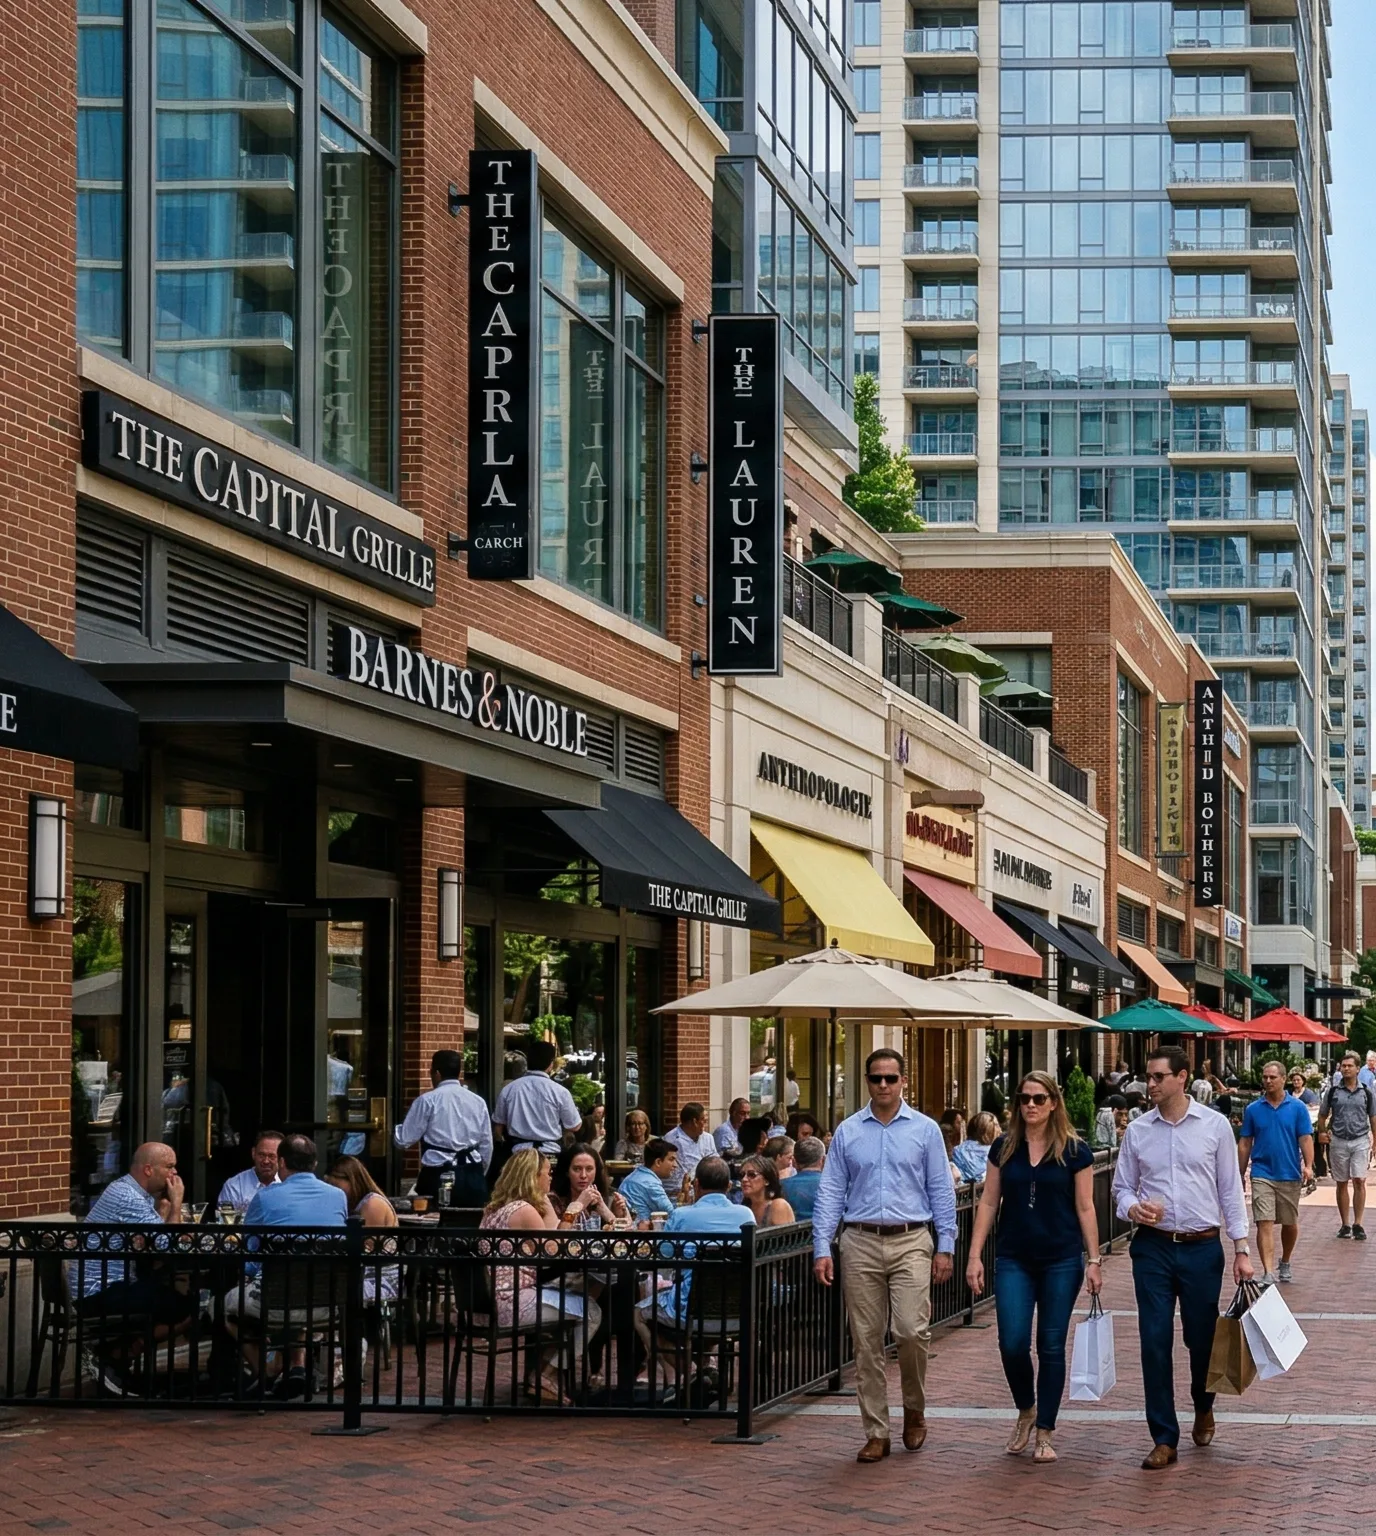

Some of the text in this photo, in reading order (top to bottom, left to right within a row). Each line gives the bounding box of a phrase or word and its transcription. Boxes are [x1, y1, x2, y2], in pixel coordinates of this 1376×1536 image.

[112, 411, 435, 593] THE CAPITAL GRILLE
[474, 537, 523, 549] CARCH
[729, 421, 759, 645] LAUREN
[348, 626, 588, 757] BARNES & NOBLE
[648, 882, 748, 922] THE CAPITAL GRILLE
[1200, 791, 1215, 900] BOTHERS
